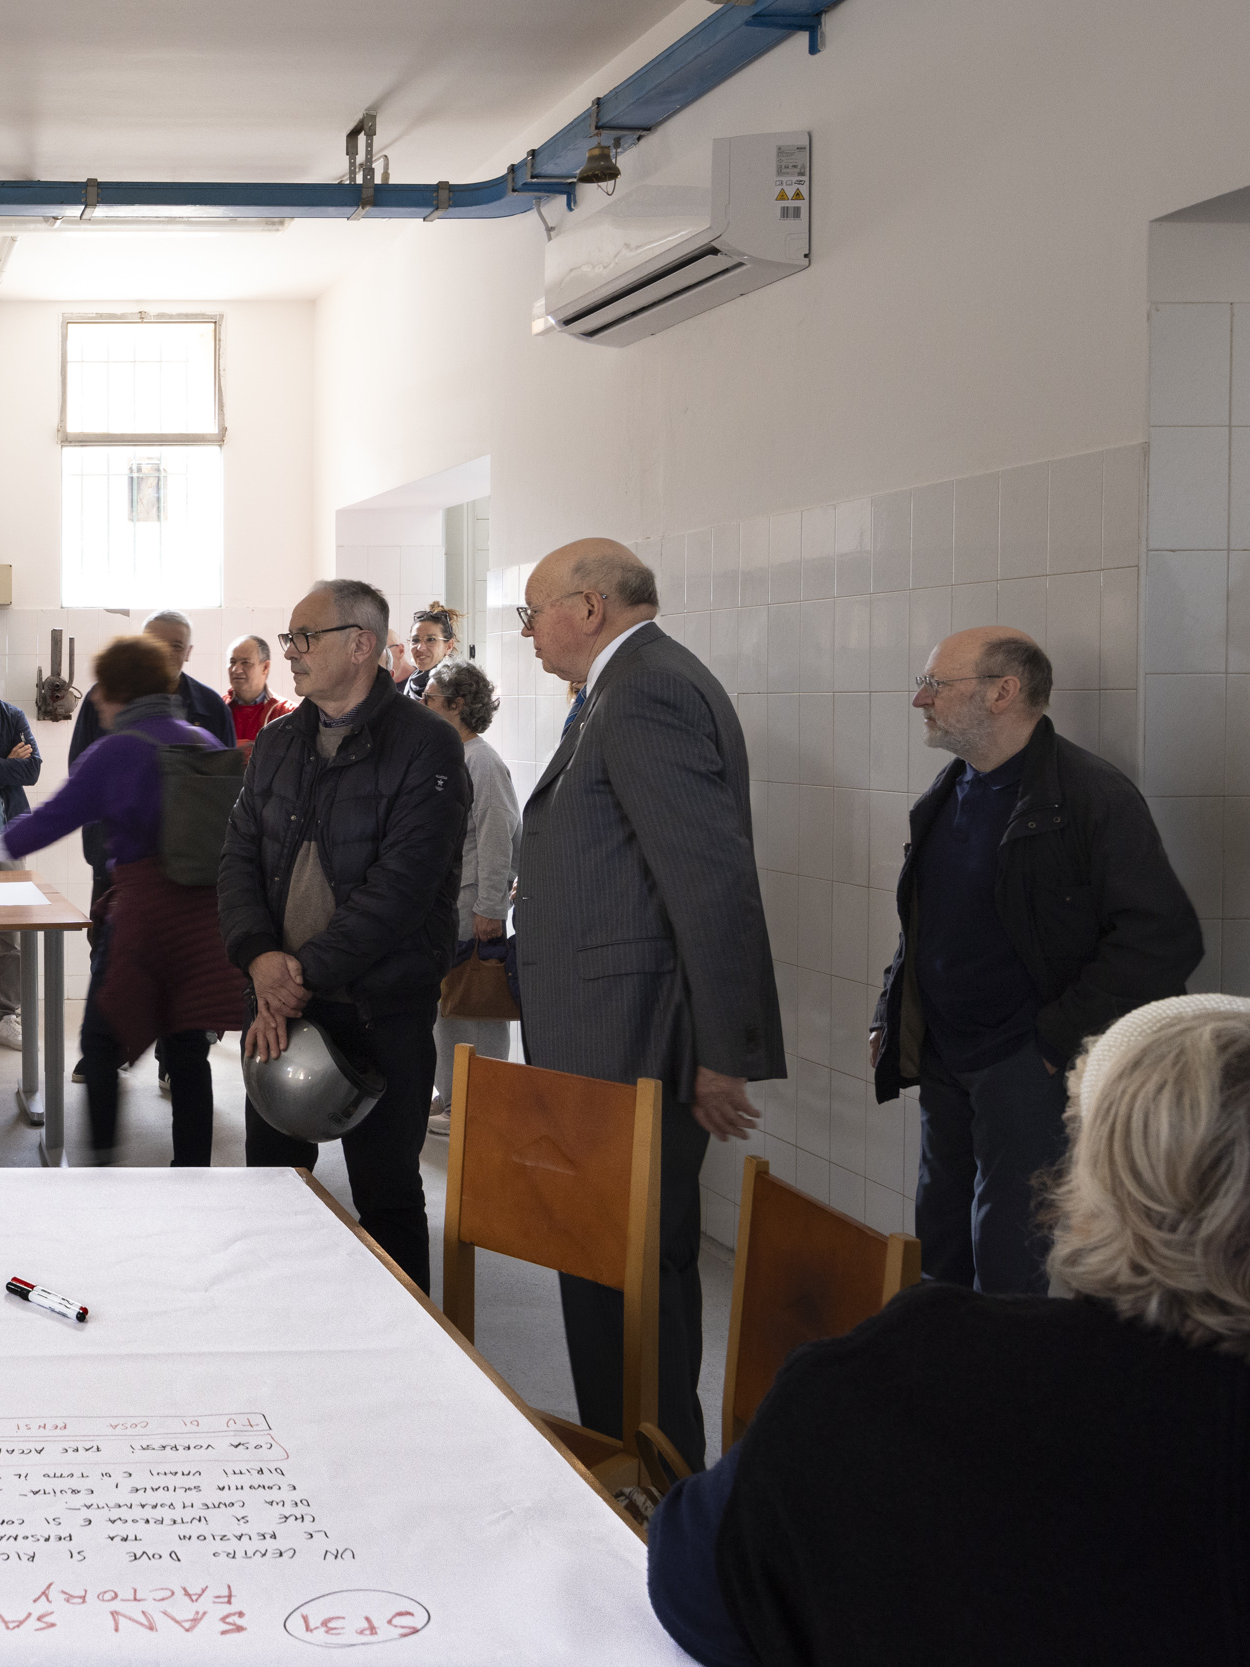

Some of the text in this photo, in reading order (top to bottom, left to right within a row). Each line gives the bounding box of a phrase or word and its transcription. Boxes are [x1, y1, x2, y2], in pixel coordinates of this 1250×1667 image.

[17, 1423, 67, 1433] PENSI
[226, 1418, 260, 1428] TU
[230, 1442, 273, 1450] COSA
[14, 1473, 29, 1481] IL
[101, 1472, 112, 1480] DI
[149, 1469, 202, 1477] UMANI
[223, 1467, 285, 1477] DIRITTI
[44, 1517, 62, 1526] SI
[81, 1518, 92, 1527] E
[106, 1515, 208, 1526] INTERROGA
[233, 1515, 249, 1524] SI
[278, 1513, 316, 1524] CHE
[107, 1534, 142, 1543] TRA
[178, 1531, 277, 1541] RELAZIONI
[304, 1530, 329, 1540] LE
[68, 1549, 86, 1562] SI
[126, 1550, 181, 1563] DOVE
[212, 1547, 297, 1559] CENTRO
[323, 1548, 355, 1561] UN
[32, 1582, 235, 1605] FACTORY
[109, 1610, 247, 1636] SAN
[300, 1610, 419, 1638] SP31
